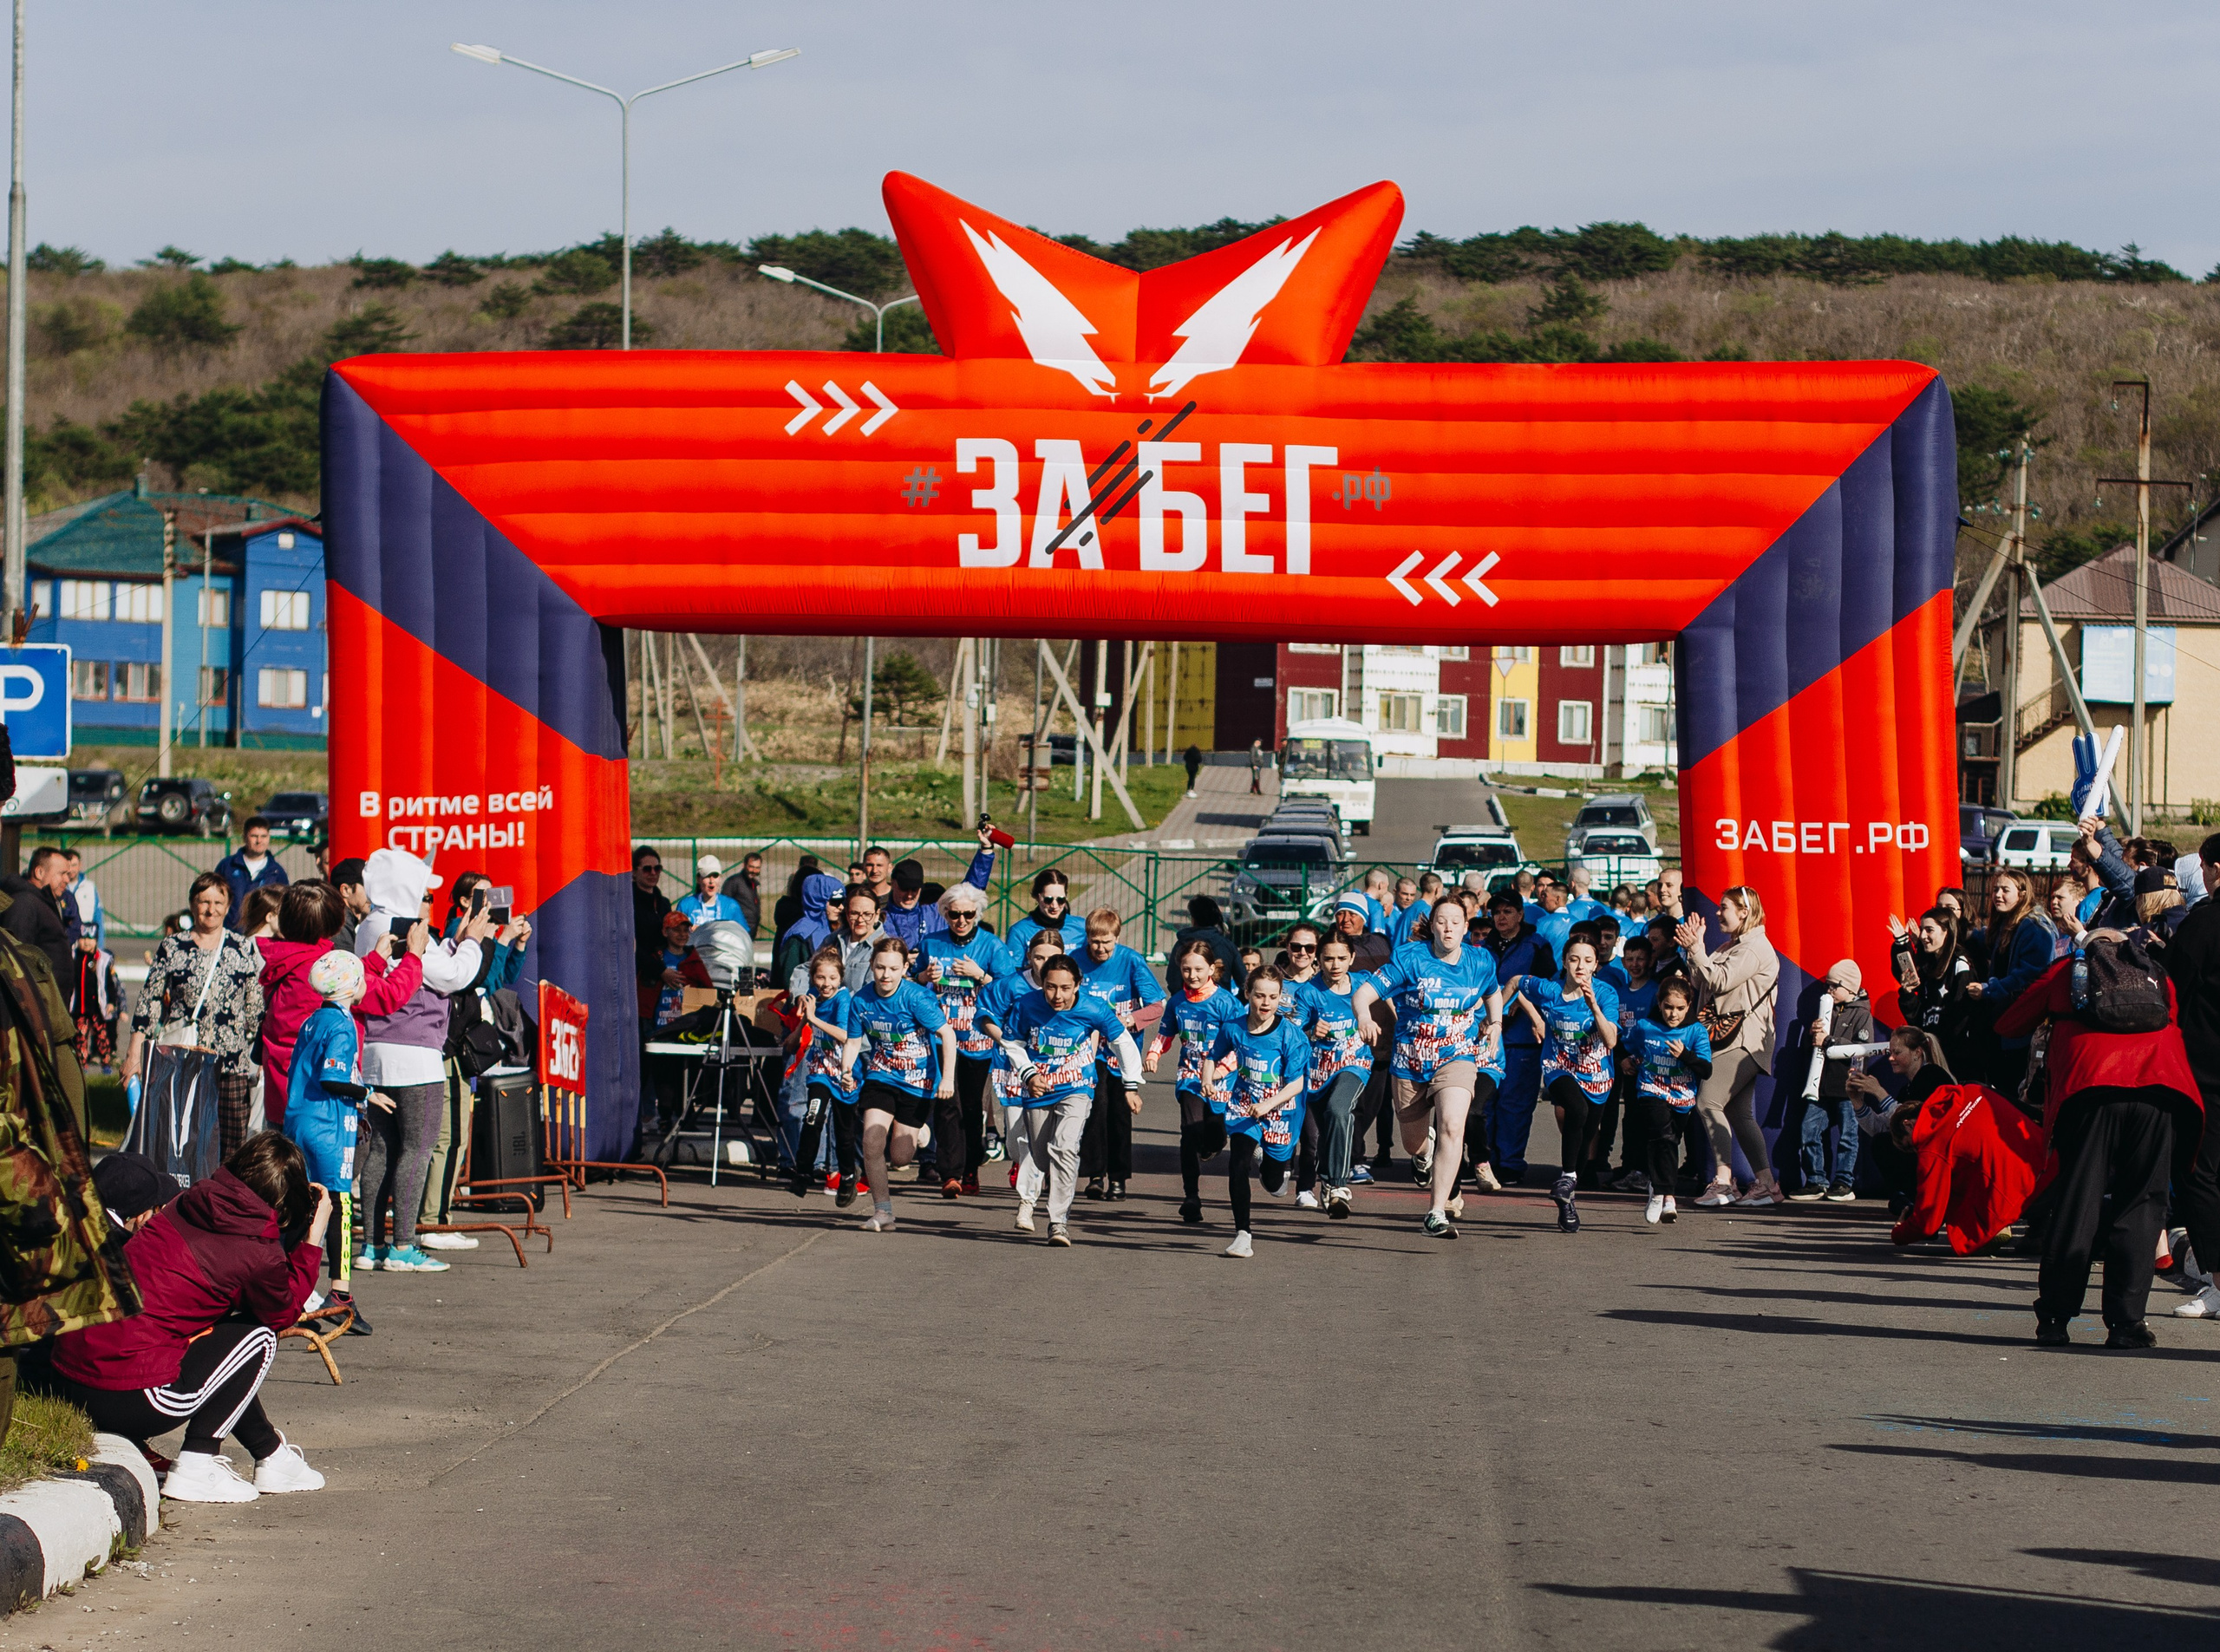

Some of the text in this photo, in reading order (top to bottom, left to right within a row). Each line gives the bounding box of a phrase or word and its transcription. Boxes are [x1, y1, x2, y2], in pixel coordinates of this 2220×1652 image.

[360, 785, 553, 820] В ритме всей
[388, 821, 525, 851] СТРАНЫ!
[1715, 818, 1929, 854] ЗАБЕГ.РФ
[1417, 977, 1441, 989] 2024
[1433, 998, 1459, 1009] 10041
[872, 1020, 892, 1031] 10017
[1555, 1020, 1580, 1031] 10005
[1048, 1036, 1073, 1047] 10013
[1244, 1056, 1269, 1071] 10015
[1652, 1055, 1677, 1066] 10006
[1656, 1067, 1670, 1076] 1КМ
